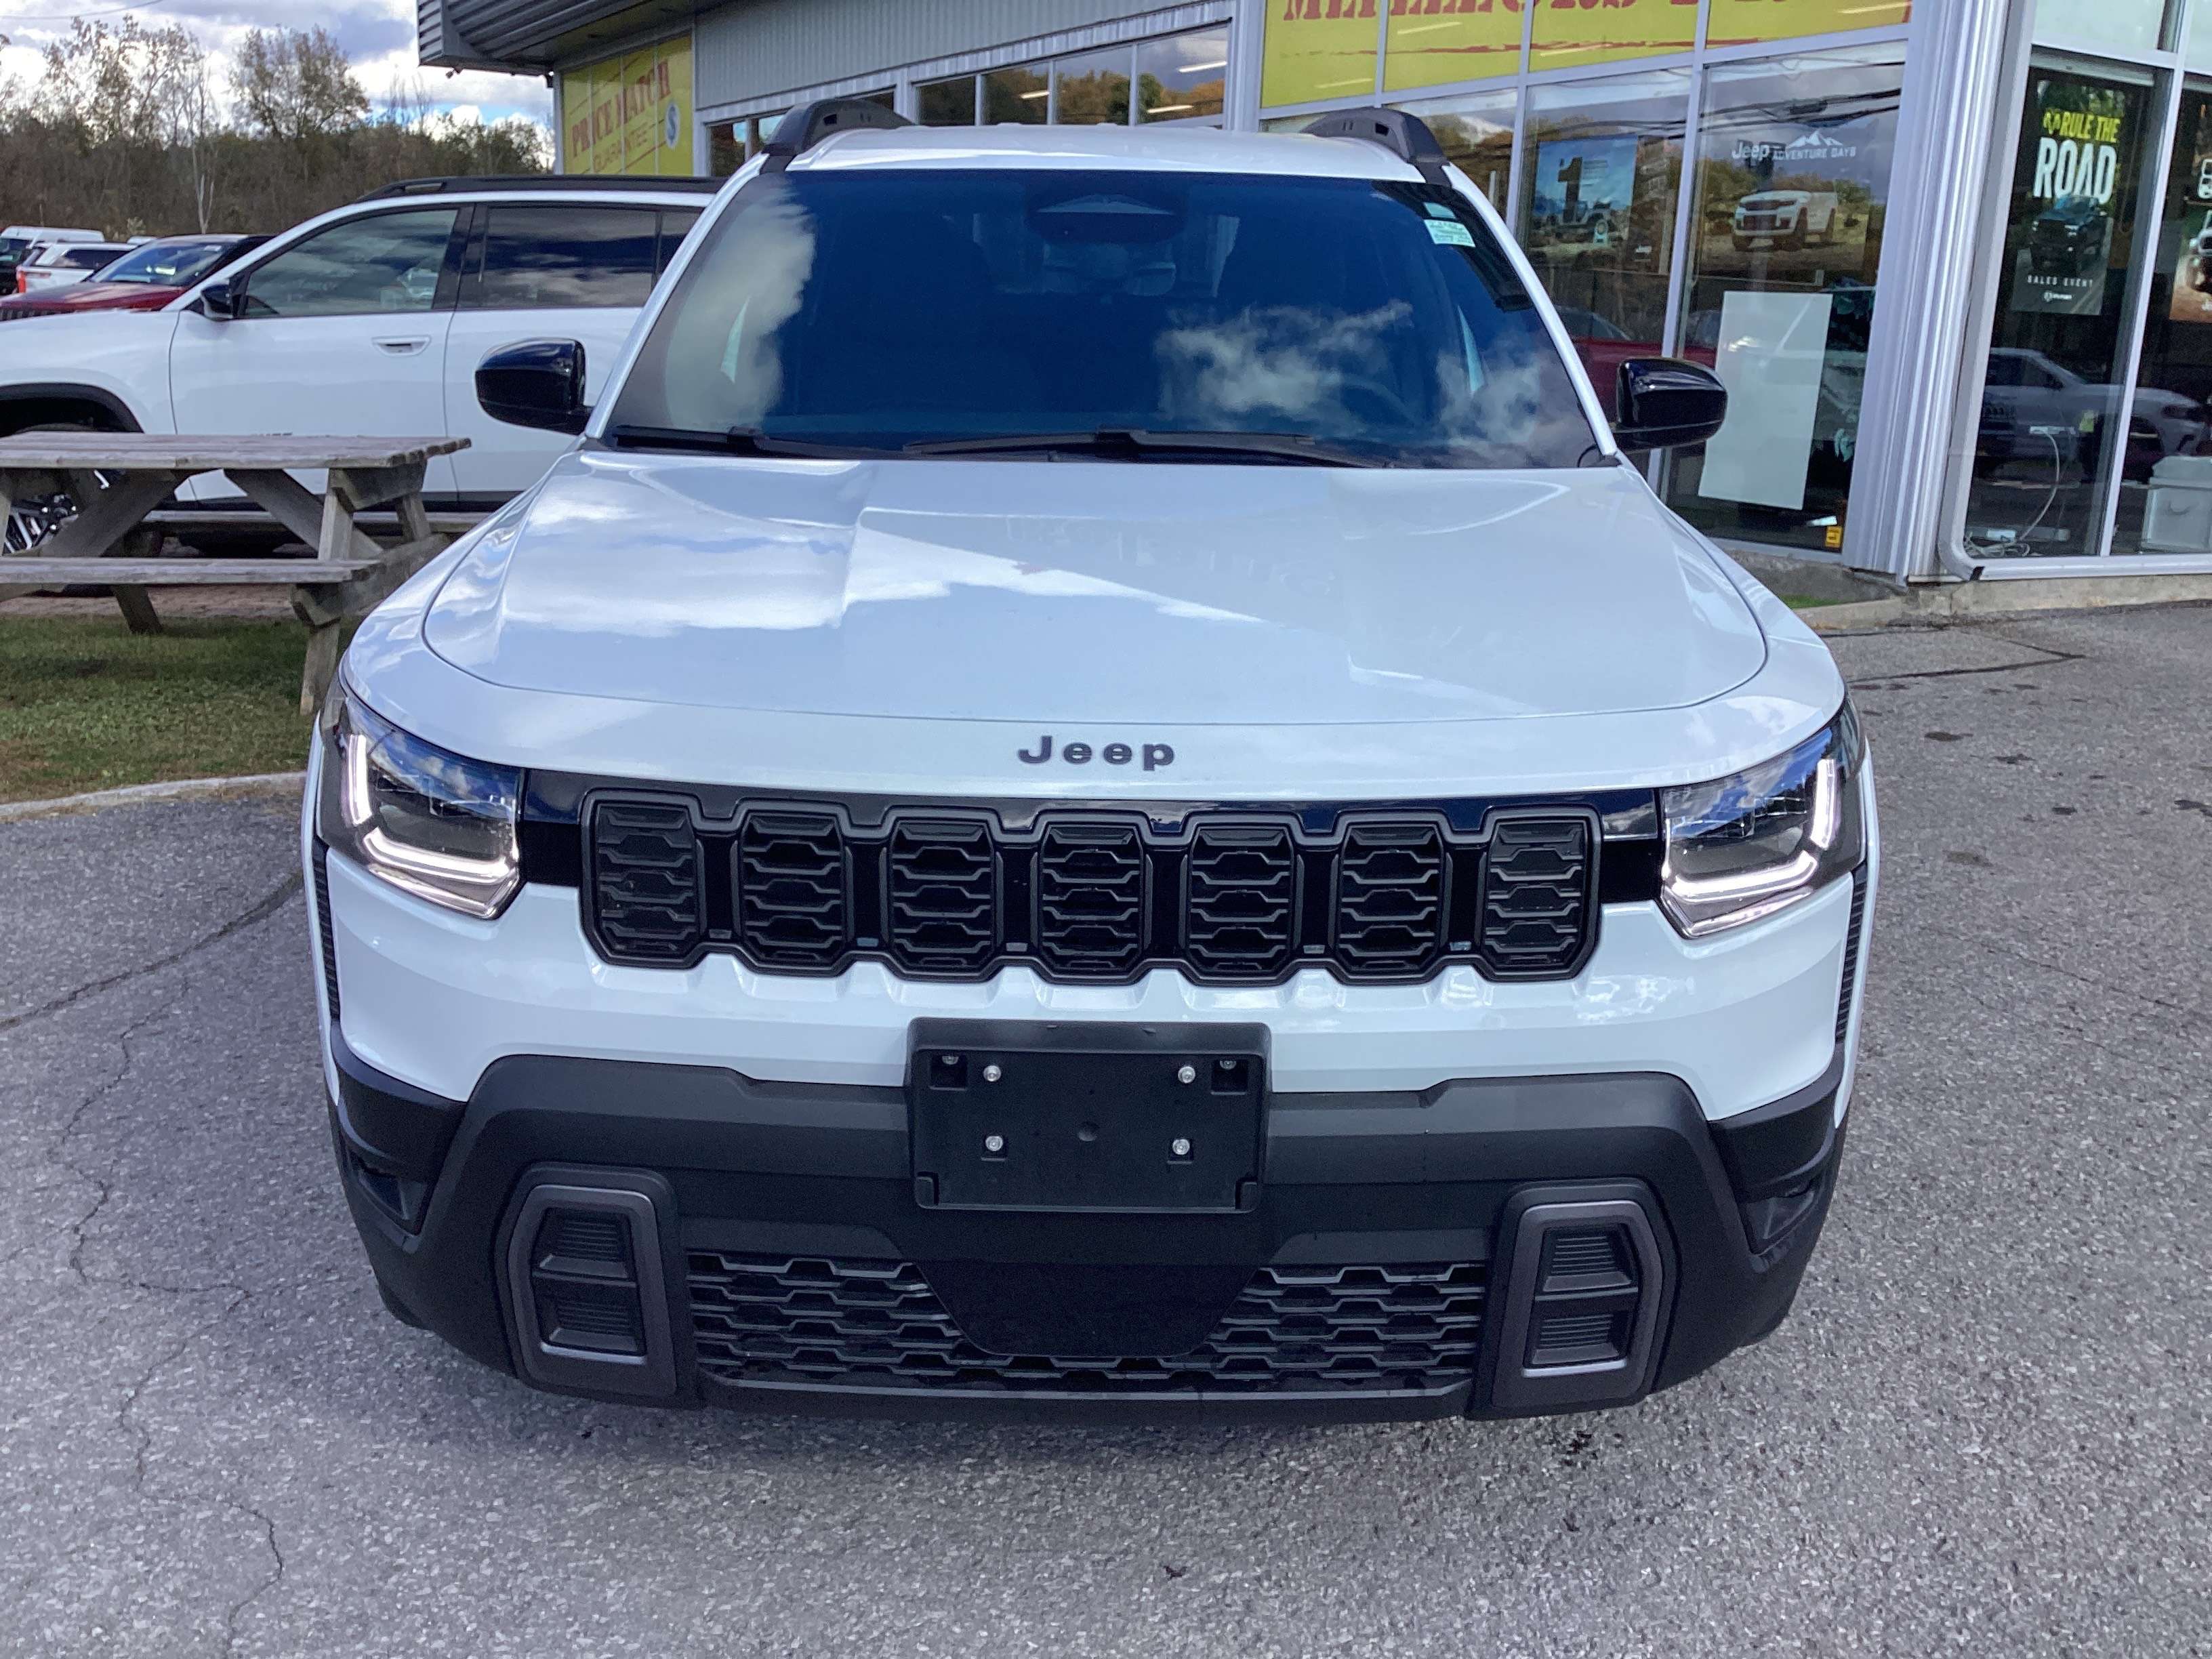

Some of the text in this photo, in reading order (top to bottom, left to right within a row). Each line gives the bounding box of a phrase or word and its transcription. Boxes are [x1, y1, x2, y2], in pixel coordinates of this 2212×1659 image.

[2060, 111, 2121, 143] RULE THE
[1732, 141, 1769, 161] Jeep
[1772, 148, 1828, 161] ADVENTURE
[2034, 137, 2117, 204] ROAD
[1018, 735, 1174, 771] Jeep
